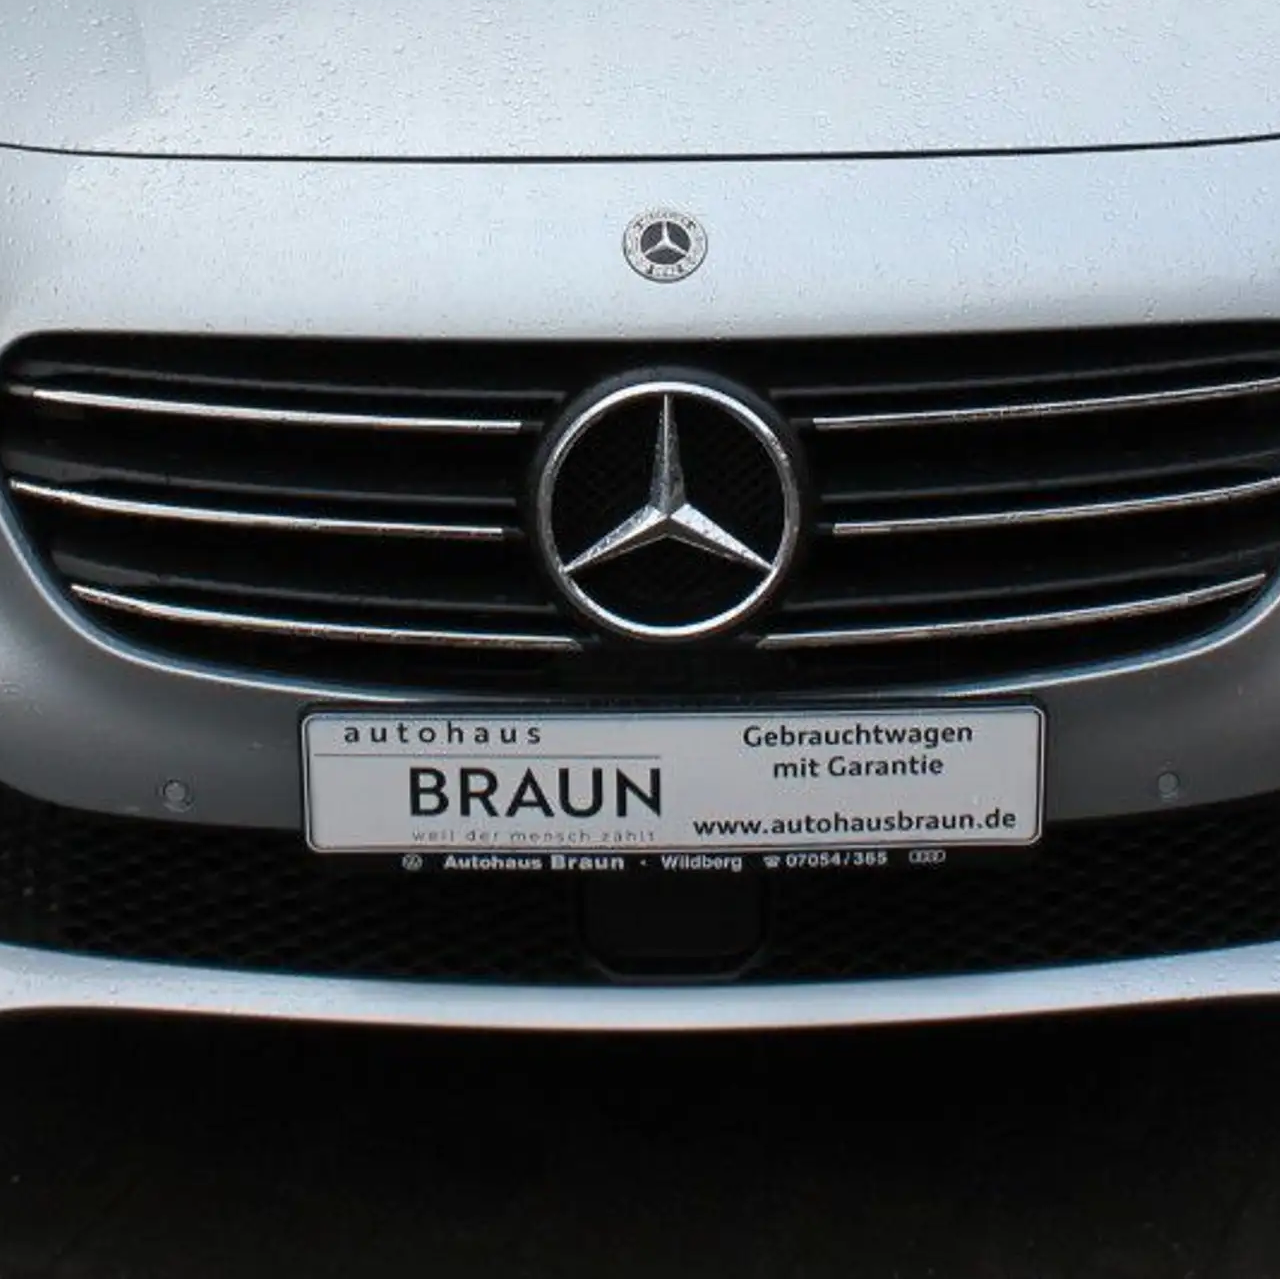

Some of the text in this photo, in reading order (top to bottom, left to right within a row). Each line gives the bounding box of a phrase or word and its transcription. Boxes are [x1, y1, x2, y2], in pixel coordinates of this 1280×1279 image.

[344, 721, 542, 745] autohaus
[742, 724, 974, 749] Gebrauchtwagen
[773, 755, 945, 779] mit Garantie
[409, 767, 662, 818] BRAUN
[693, 809, 1017, 836] www.autohausbraun.de
[443, 853, 543, 870] Autohaus
[551, 853, 625, 870] Braun
